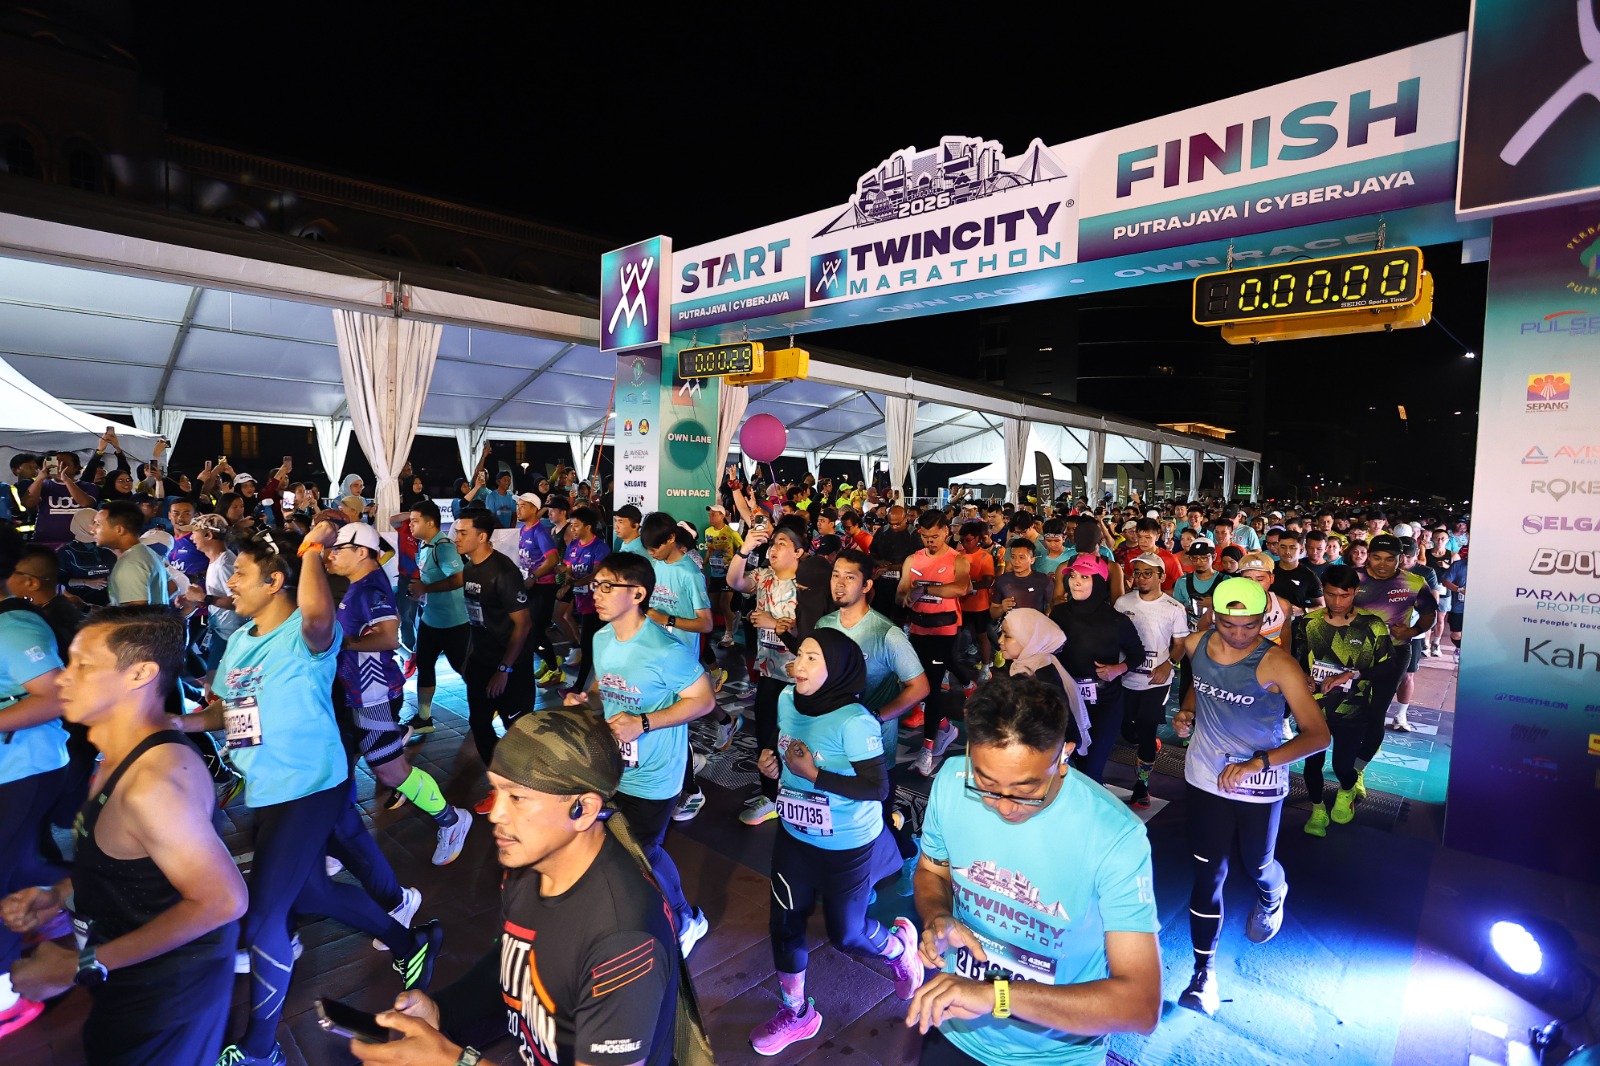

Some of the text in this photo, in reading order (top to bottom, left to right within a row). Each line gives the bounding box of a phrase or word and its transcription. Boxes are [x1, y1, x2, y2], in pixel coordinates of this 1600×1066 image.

[1116, 77, 1420, 198] FINISH
[897, 195, 951, 218] 2026
[1113, 205, 1238, 240] PUTRAJAYA
[1255, 170, 1415, 214] CYBERJAYA
[851, 201, 1062, 271] TWINCITY
[681, 238, 790, 293] START
[850, 242, 1061, 296] MARATHON
[1114, 231, 1378, 278] OWN RACE
[679, 304, 727, 320] PUTRAJAYA
[733, 291, 789, 310] CYBERJAYA
[877, 298, 941, 314] OWN
[1341, 300, 1366, 308] SEIKO
[1526, 402, 1569, 411] SEPANG
[667, 432, 712, 444] OWN LANE
[666, 489, 710, 497] OWN PACE
[1540, 618, 1577, 628] People's
[1523, 637, 1600, 672] Kah
[788, 802, 823, 825] D17135
[960, 902, 1064, 950] MARATHON
[962, 887, 1066, 940] TWINCITY
[590, 1040, 642, 1054] IMPOSSIBLE
